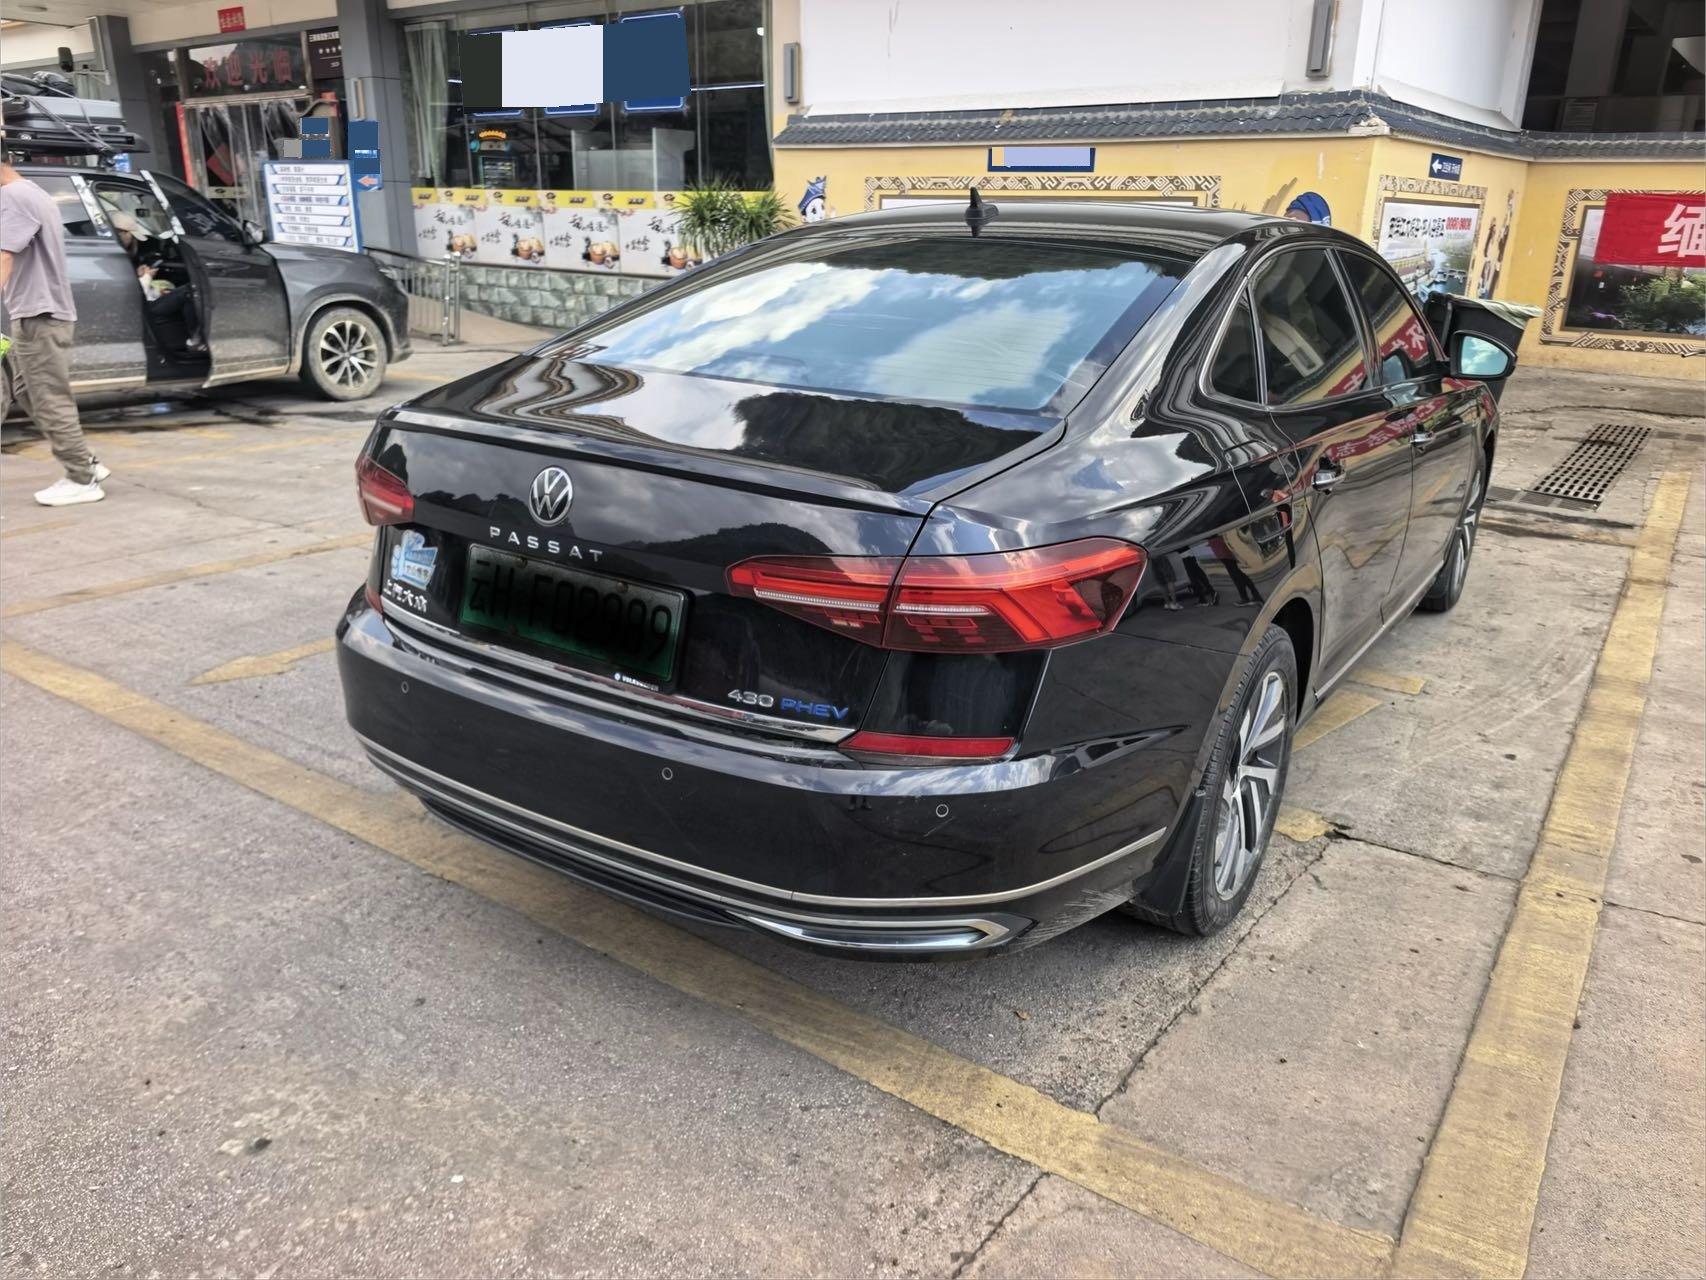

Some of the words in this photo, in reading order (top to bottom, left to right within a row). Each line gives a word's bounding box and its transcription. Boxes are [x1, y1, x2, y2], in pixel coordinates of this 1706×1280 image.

[203, 48, 293, 88] 欢迎光临
[489, 526, 603, 562] PASSAT
[383, 579, 428, 612] 上汽大众
[728, 689, 774, 708] 430
[780, 697, 849, 720] PHEV
